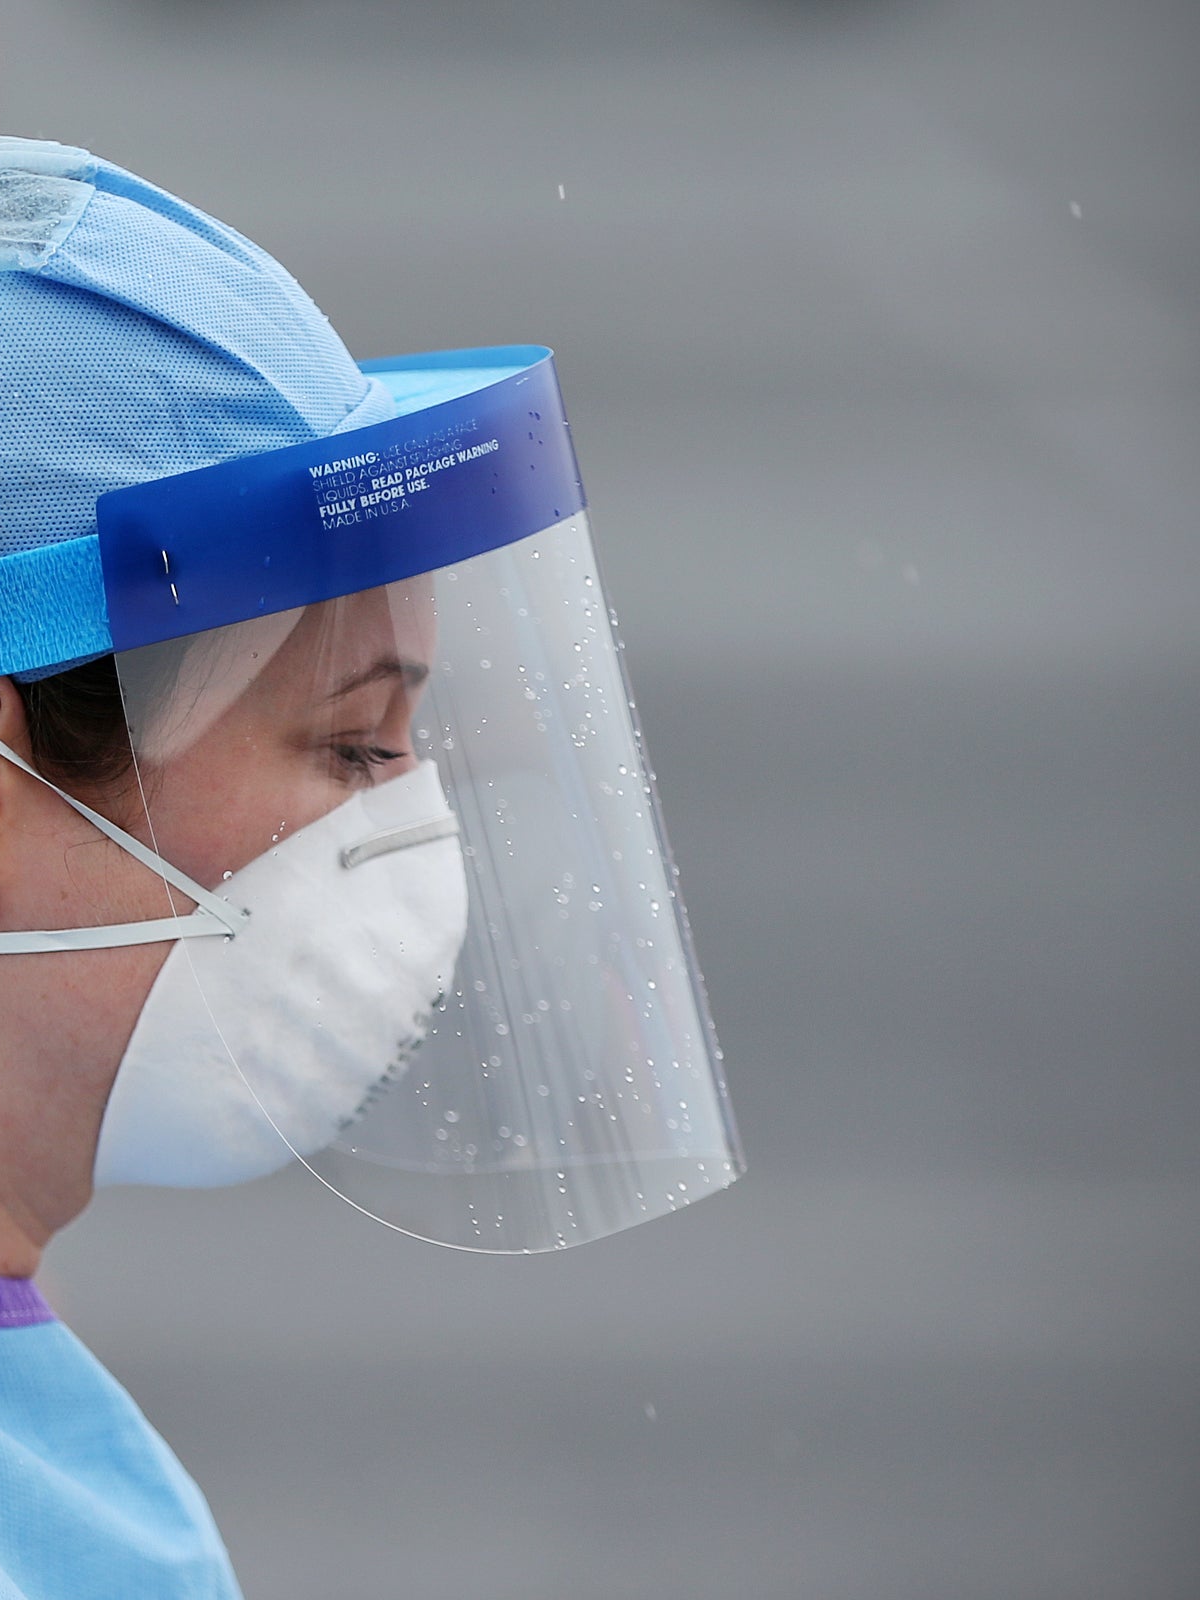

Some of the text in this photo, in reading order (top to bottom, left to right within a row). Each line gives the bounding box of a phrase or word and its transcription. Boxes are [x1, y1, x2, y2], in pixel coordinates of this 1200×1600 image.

[309, 452, 381, 478] WARNING:
[383, 443, 402, 459] USE
[312, 439, 462, 492] SHIELD AGAINST SPLASHING
[371, 472, 403, 490] READ
[405, 454, 456, 480] PACKAGE
[456, 439, 499, 463] WARNING
[319, 478, 431, 518] FULLY BEFORE USE.
[322, 511, 363, 531] MADE
[365, 507, 379, 520] IN
